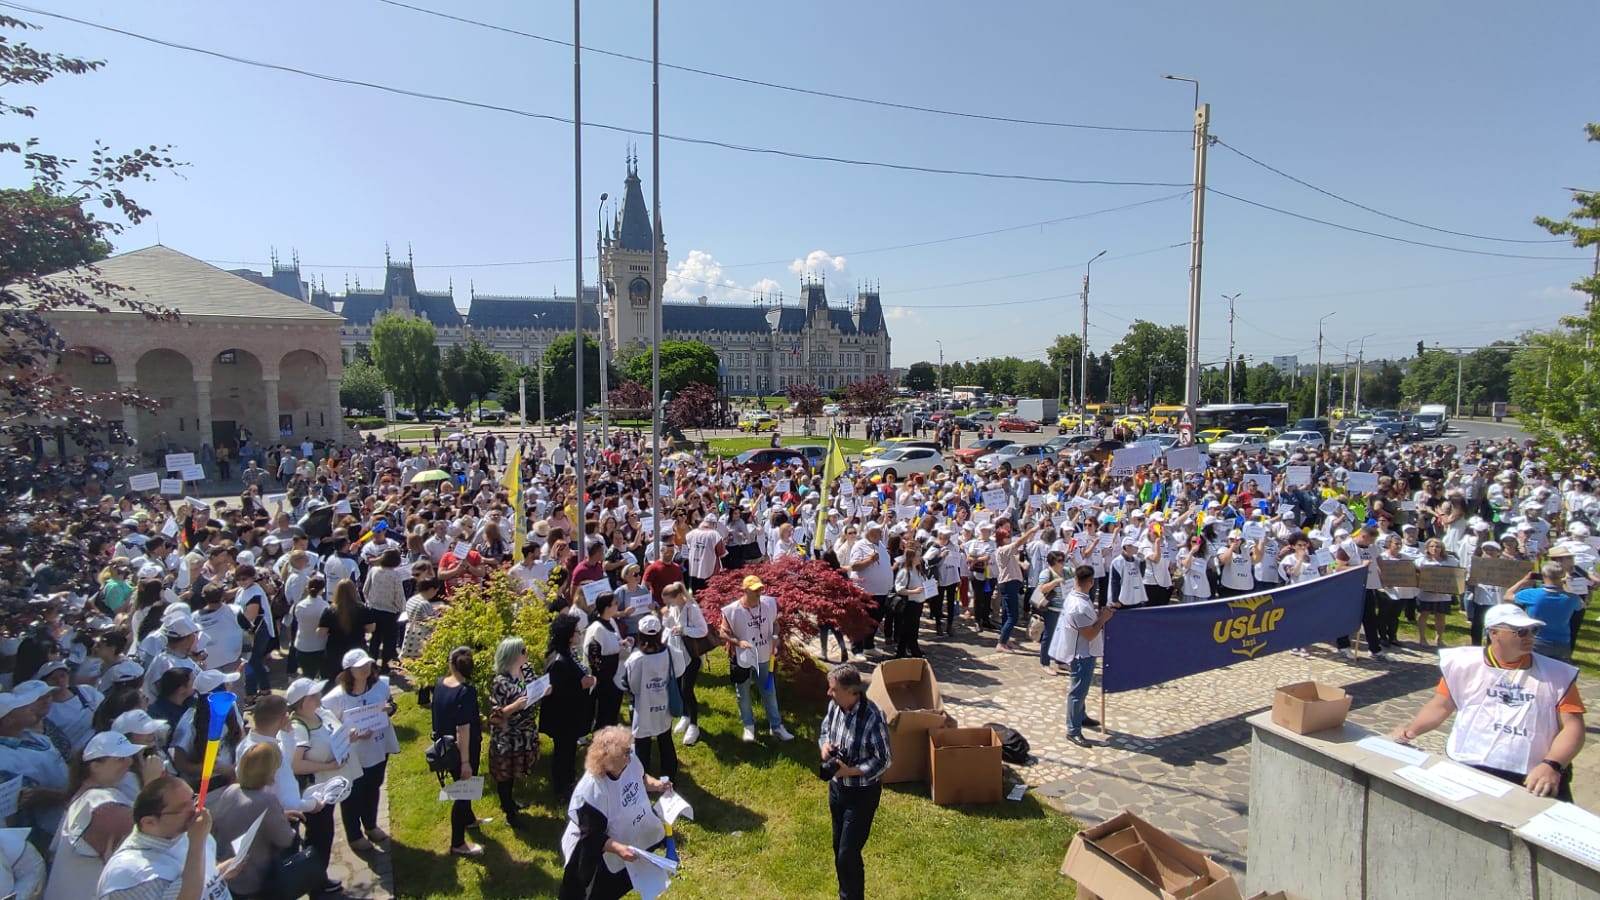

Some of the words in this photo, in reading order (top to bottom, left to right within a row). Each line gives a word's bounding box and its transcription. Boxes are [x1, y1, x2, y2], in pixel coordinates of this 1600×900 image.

[1213, 607, 1285, 644] USLIP
[1486, 688, 1535, 702] USLIP
[1493, 722, 1528, 737] FSLI
[621, 782, 639, 807] USLIP
